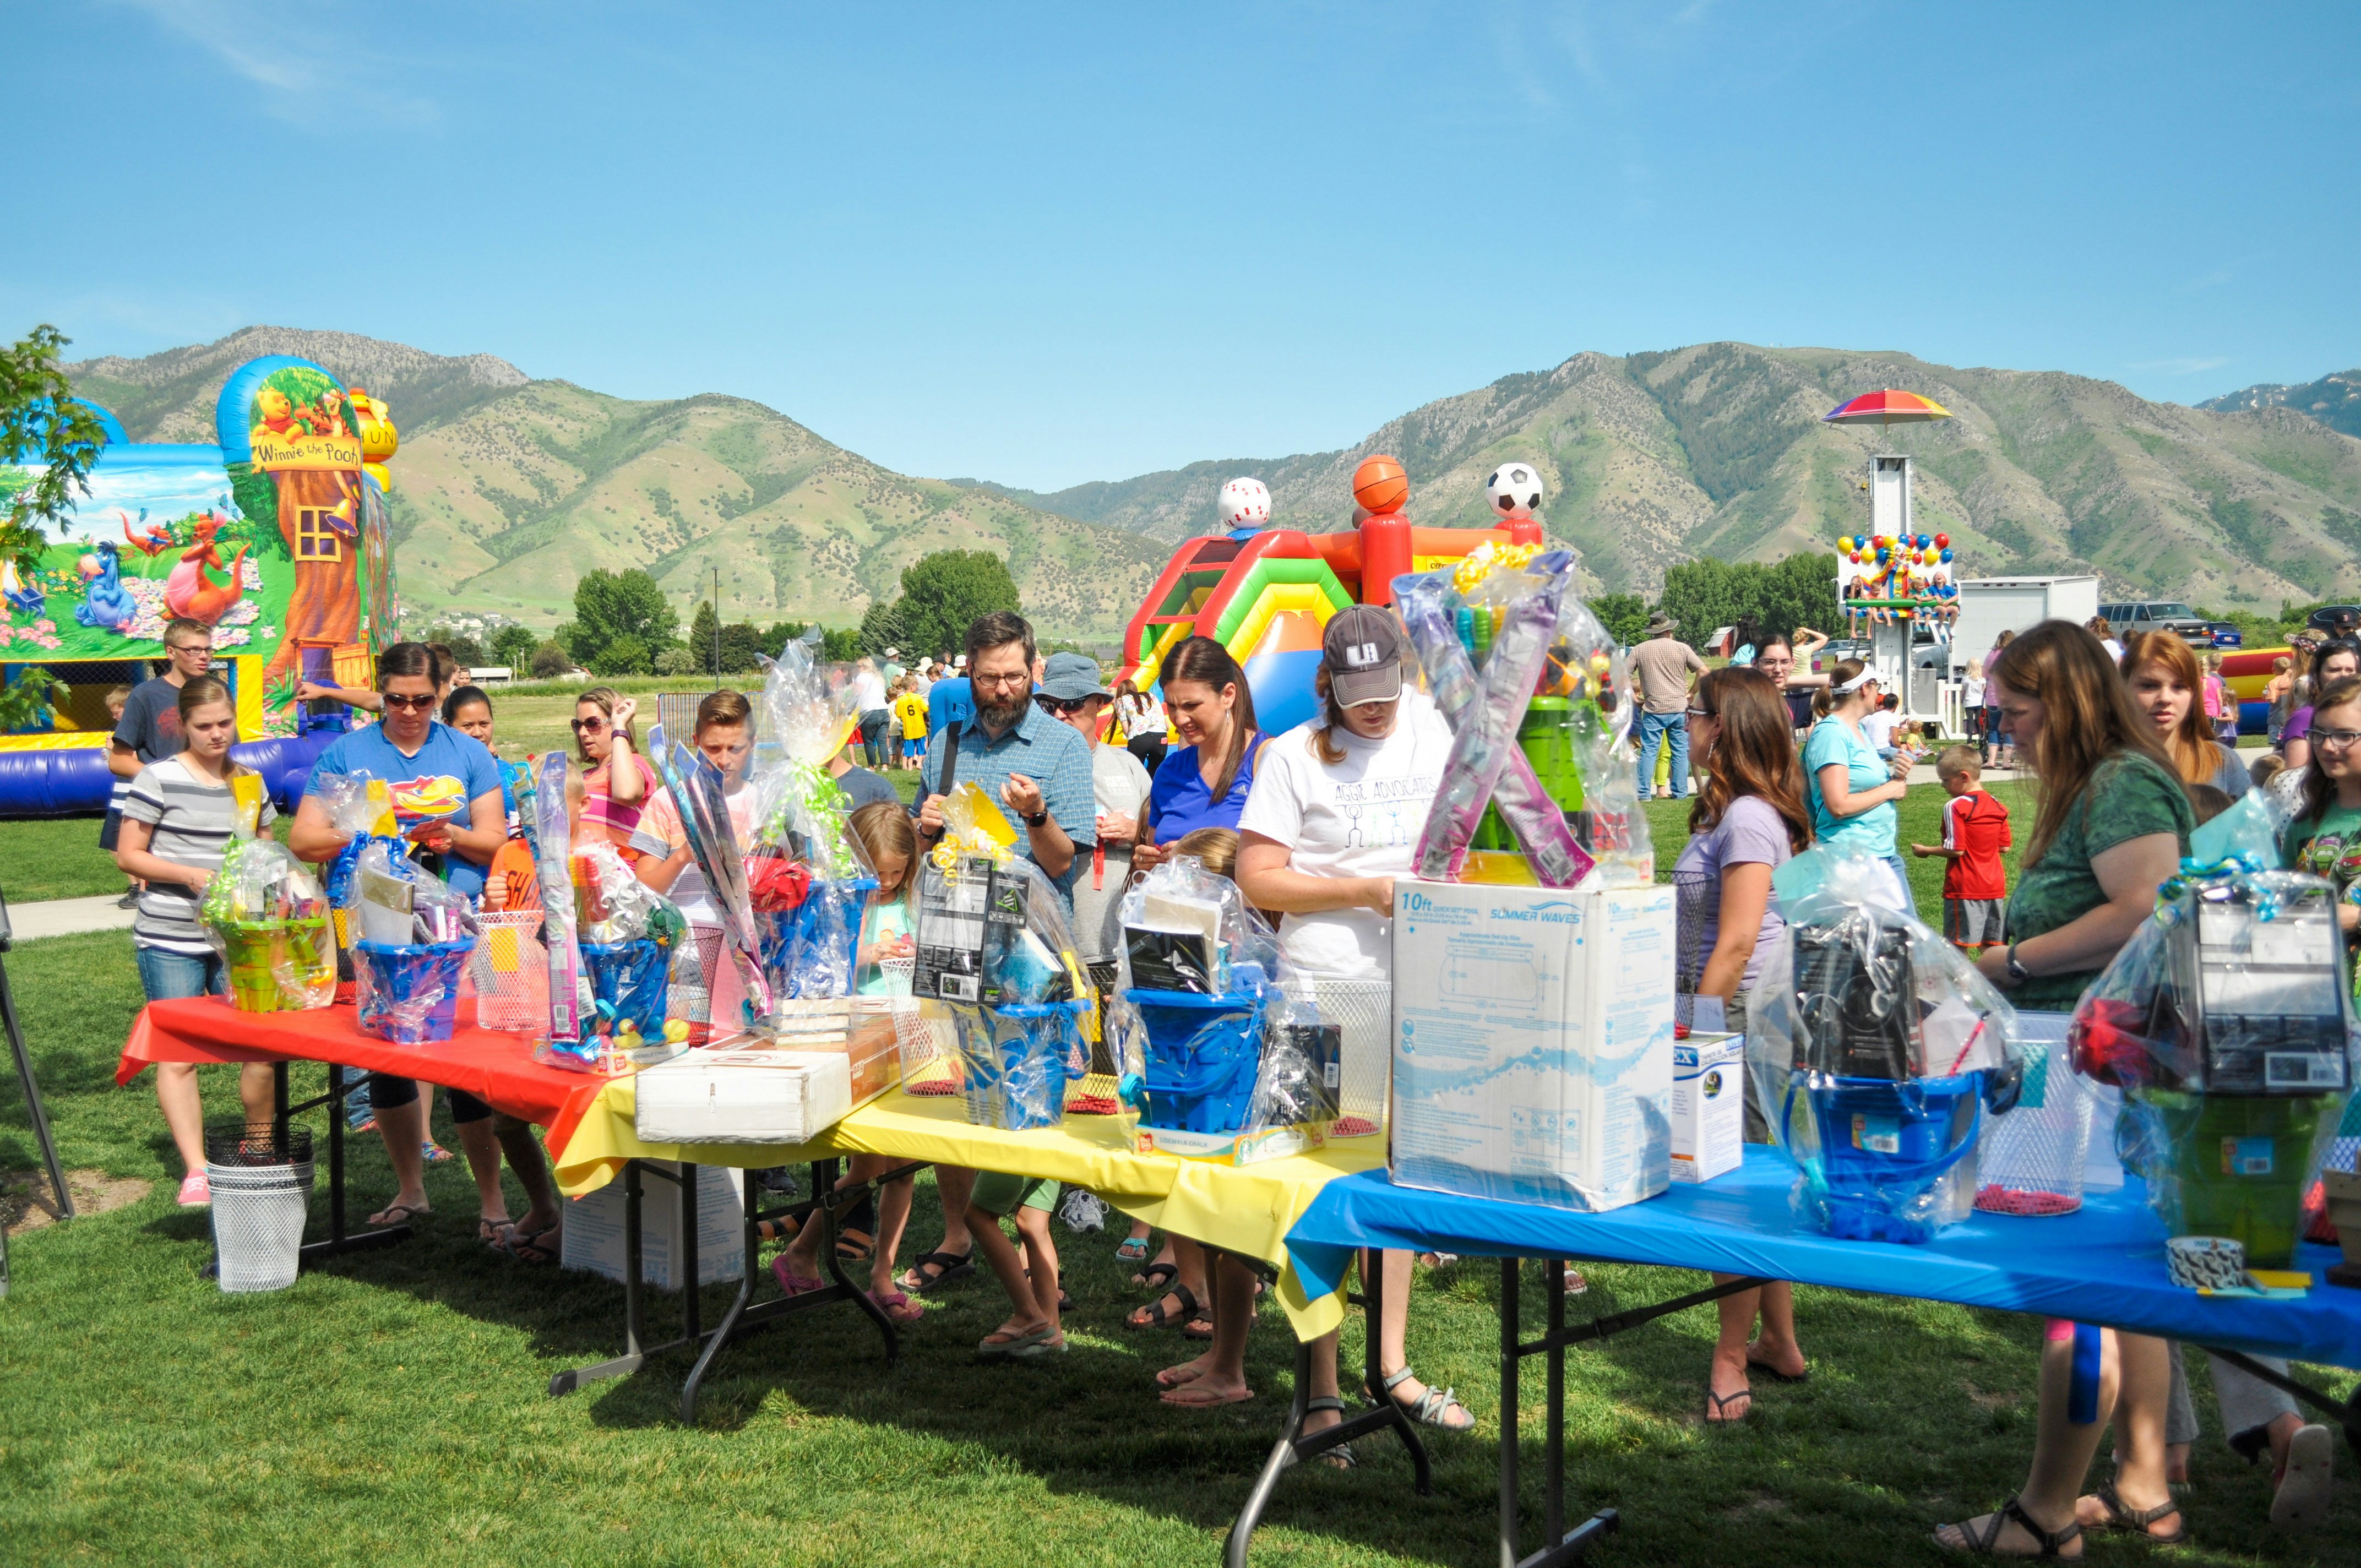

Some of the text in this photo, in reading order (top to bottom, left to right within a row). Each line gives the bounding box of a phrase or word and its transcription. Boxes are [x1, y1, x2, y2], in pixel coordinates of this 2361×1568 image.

[258, 442, 358, 466] Winnie the Pooh
[907, 705, 915, 716] 6
[1335, 783, 1367, 803] AGGIE
[1402, 892, 1432, 912] 10ft
[1490, 909, 1580, 924] SUMMER WAVES
[1159, 1137, 1188, 1146] SIDEWALK
